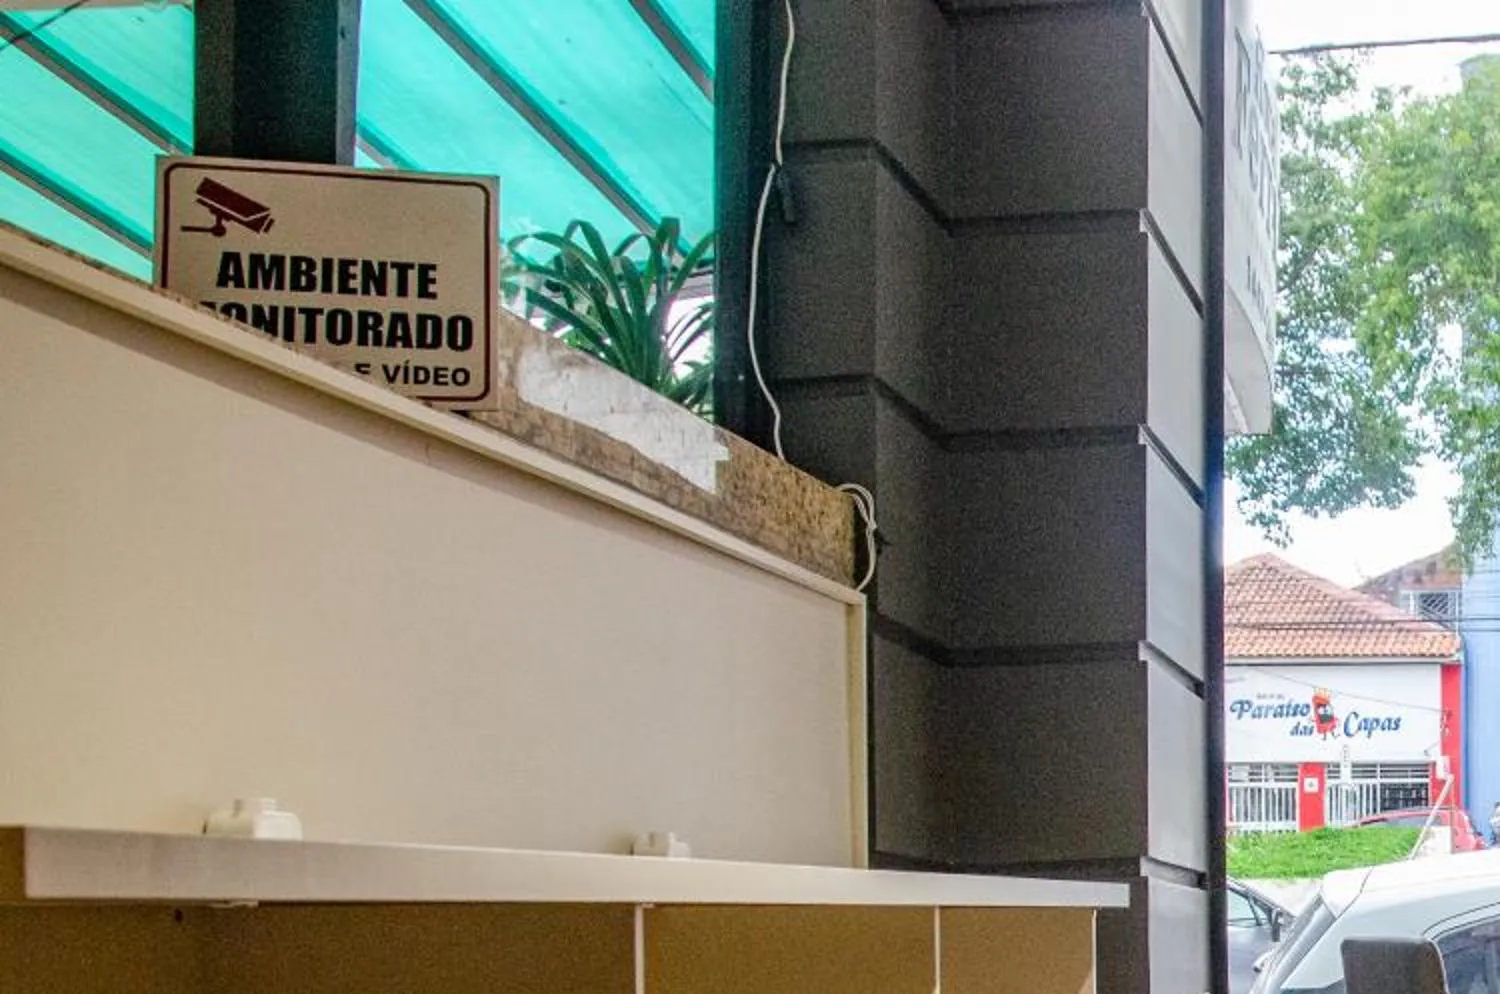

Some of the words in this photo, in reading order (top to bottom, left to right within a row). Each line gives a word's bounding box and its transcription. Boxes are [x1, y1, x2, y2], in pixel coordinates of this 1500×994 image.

[216, 251, 439, 299] AMBIENTE
[200, 301, 474, 352] NITORADO
[382, 360, 471, 387] VÍDEO
[1343, 711, 1402, 739] Capas
